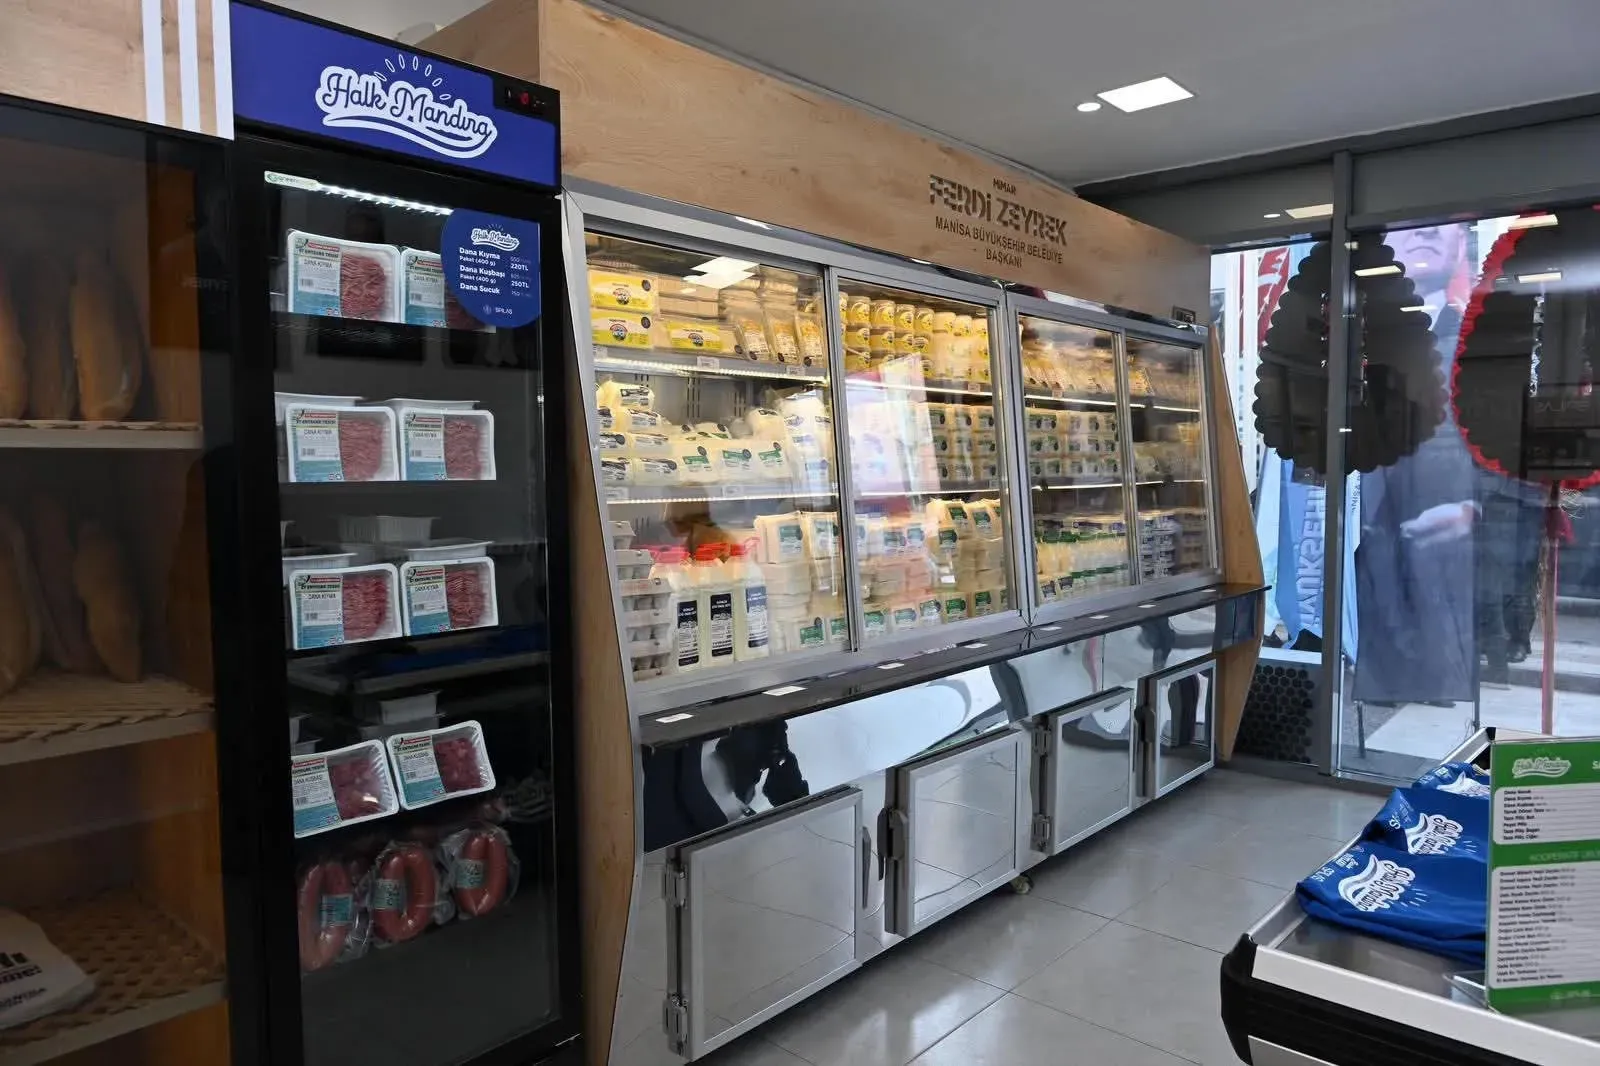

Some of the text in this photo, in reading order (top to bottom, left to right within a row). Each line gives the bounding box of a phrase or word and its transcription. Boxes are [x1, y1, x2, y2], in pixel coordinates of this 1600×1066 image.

[321, 72, 388, 111] Halk
[996, 197, 1068, 246] ZEYREK
[459, 247, 501, 260] Dana Kıyma
[459, 265, 478, 274] Dana
[459, 282, 501, 294] Dana Sucuk
